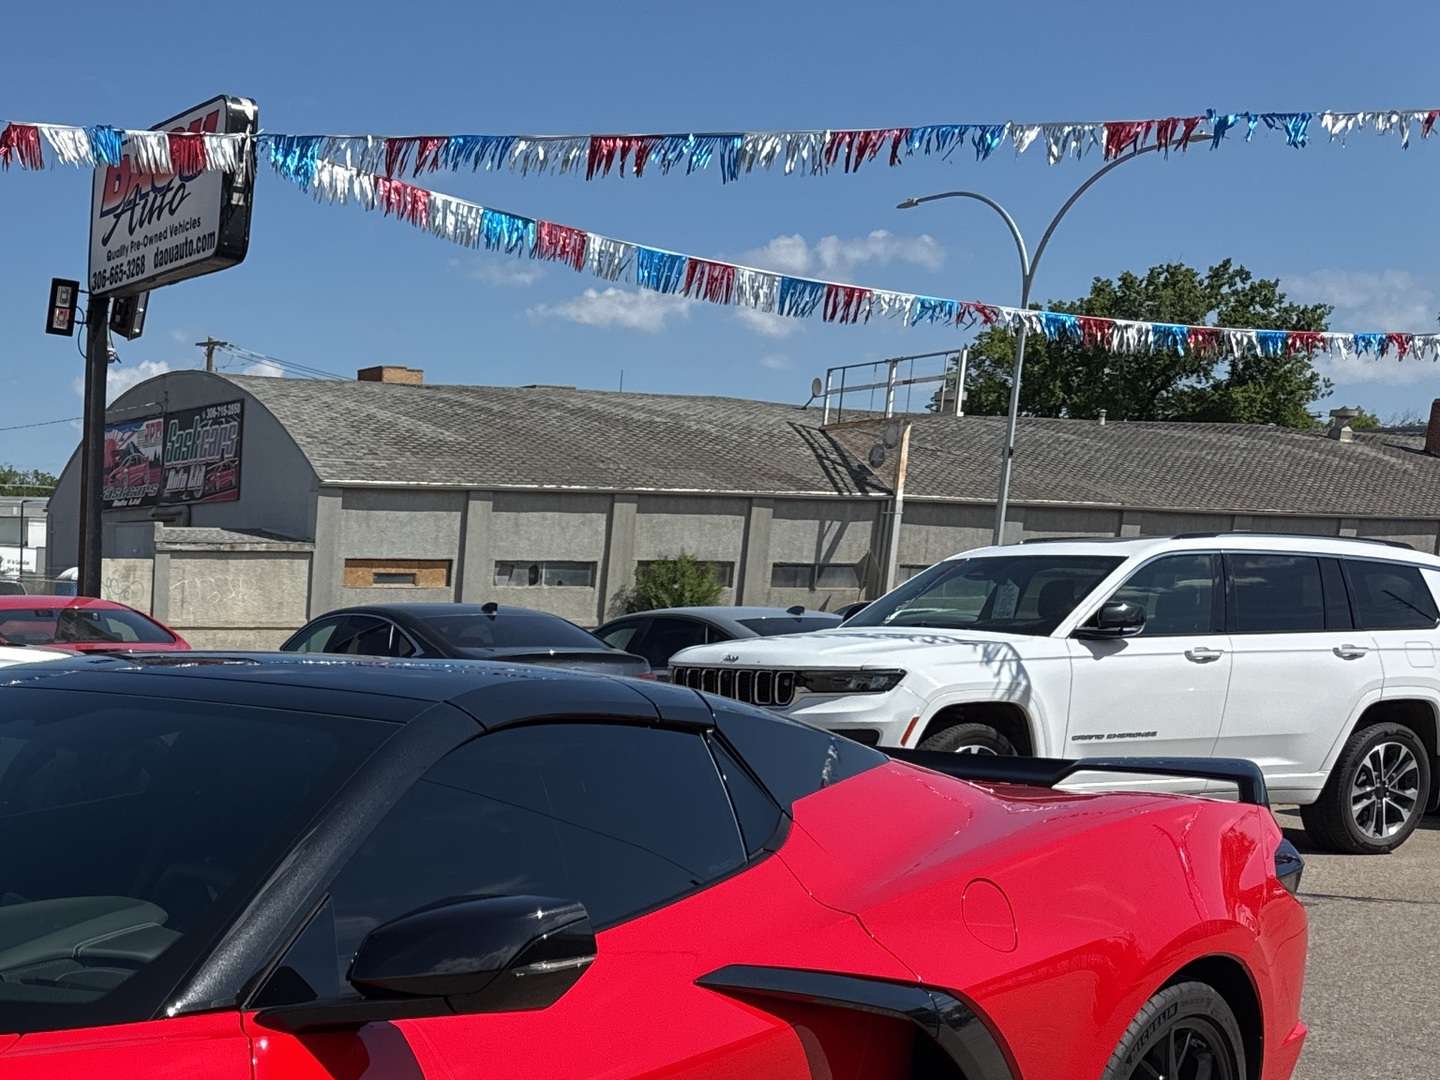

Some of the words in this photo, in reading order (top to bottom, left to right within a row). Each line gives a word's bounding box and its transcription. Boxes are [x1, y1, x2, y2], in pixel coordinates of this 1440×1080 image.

[102, 178, 191, 246] Auto
[106, 242, 129, 261] Quality
[131, 227, 168, 254] Pre-Owned
[169, 217, 201, 238] Vehicles
[91, 255, 146, 291] 306-665-3268
[154, 231, 216, 269] daouauto.com
